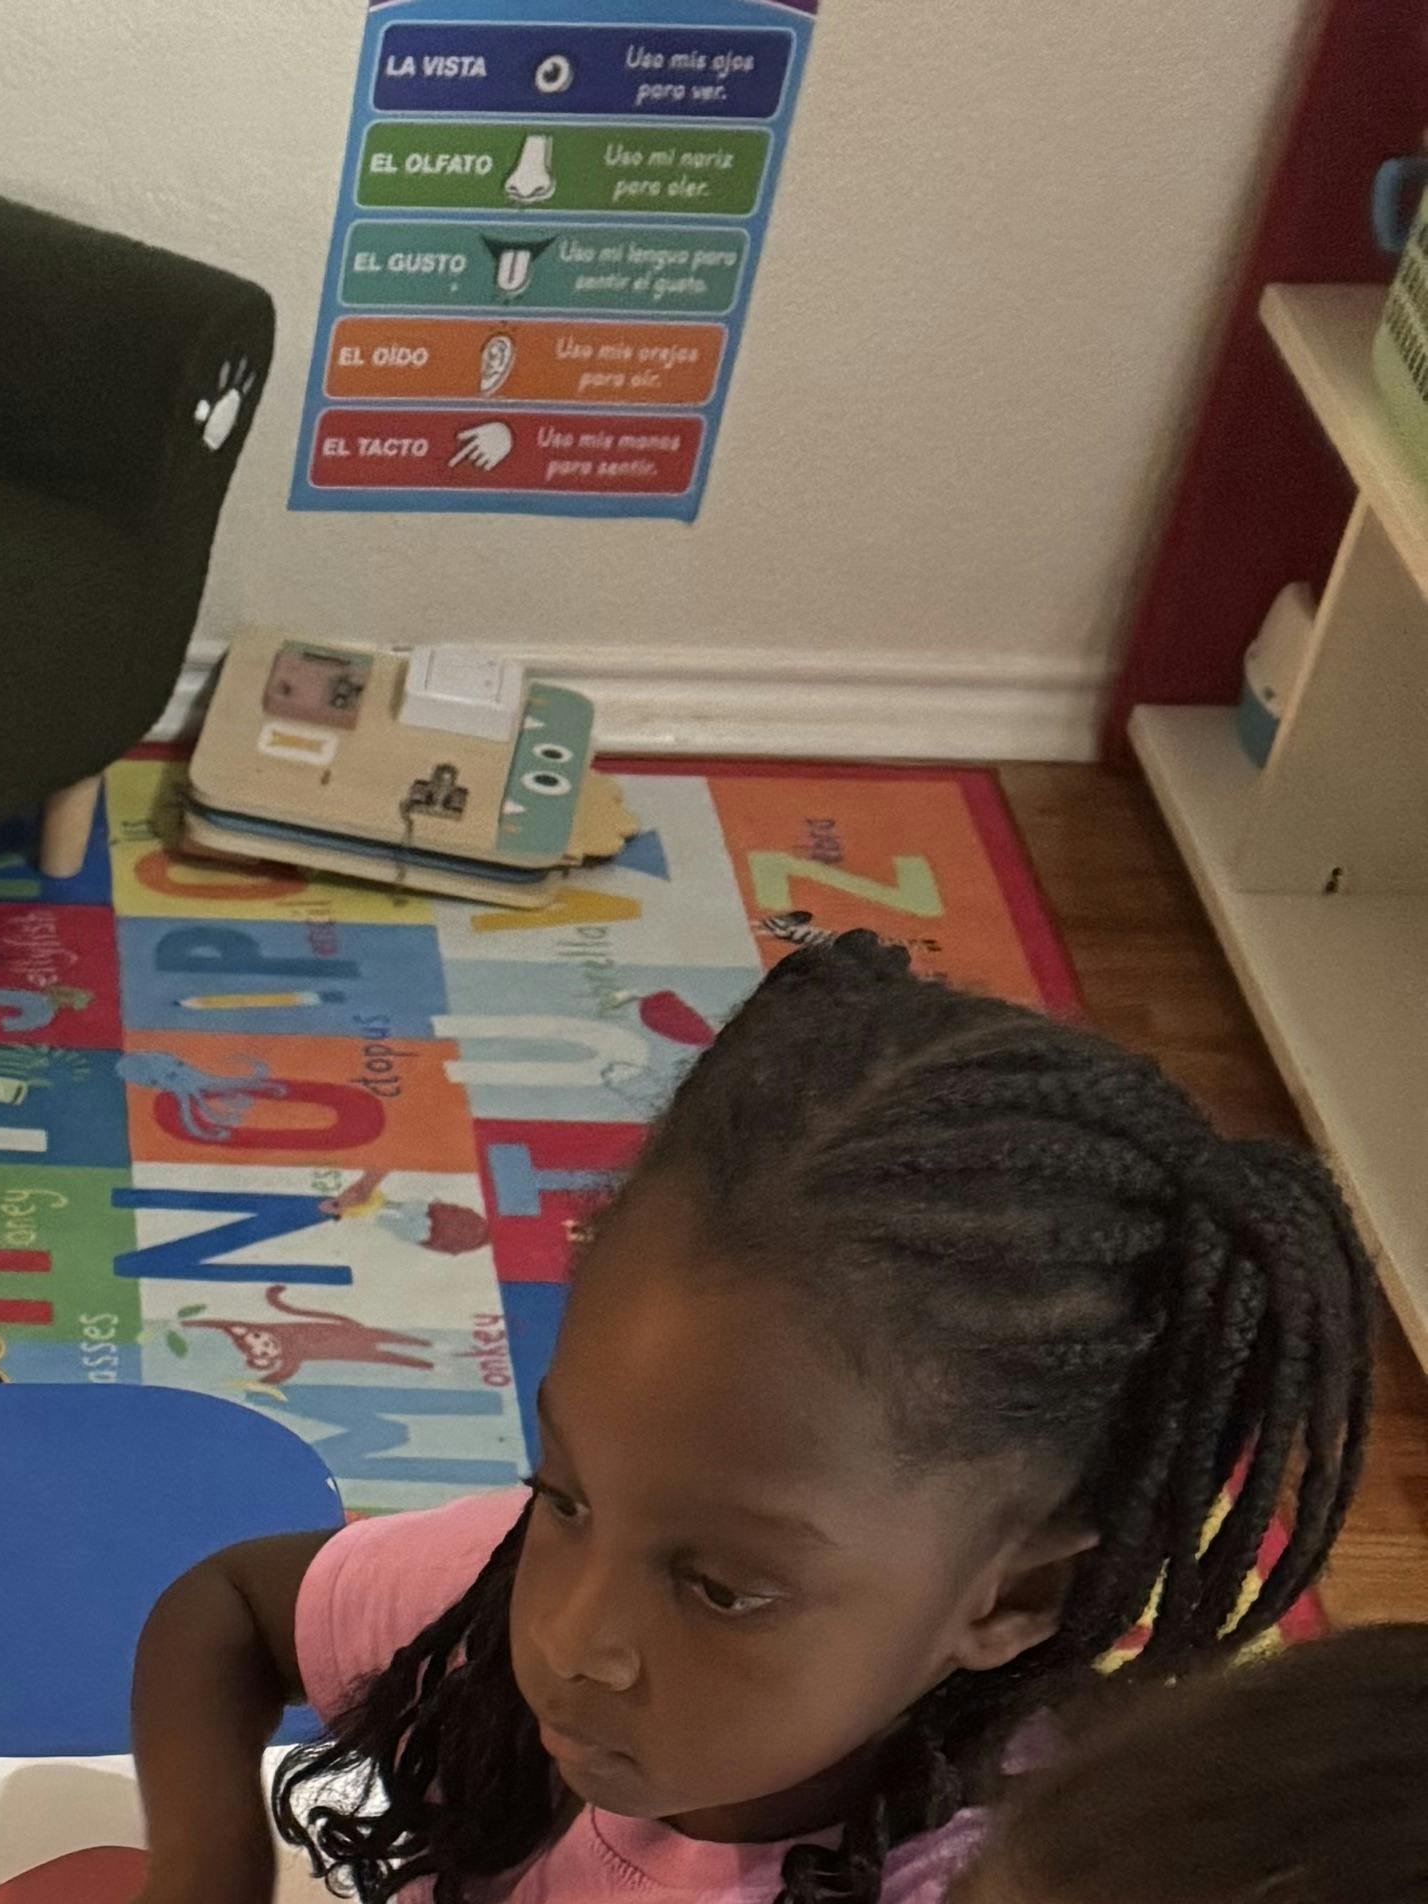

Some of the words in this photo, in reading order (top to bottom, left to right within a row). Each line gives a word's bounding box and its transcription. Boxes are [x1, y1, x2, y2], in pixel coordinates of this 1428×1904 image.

[386, 56, 415, 77] LA
[422, 56, 487, 77] VISTA
[625, 45, 664, 69] Uso
[669, 51, 706, 70] mis
[635, 83, 686, 106] para
[370, 153, 398, 174] EL
[405, 153, 493, 175] OLFATO
[604, 144, 643, 167] Uso
[613, 178, 661, 202] para
[353, 252, 382, 272] EL
[388, 252, 467, 273] GUSTO
[338, 346, 365, 366] EL
[323, 437, 351, 457] EL
[358, 437, 429, 457] TACTO
